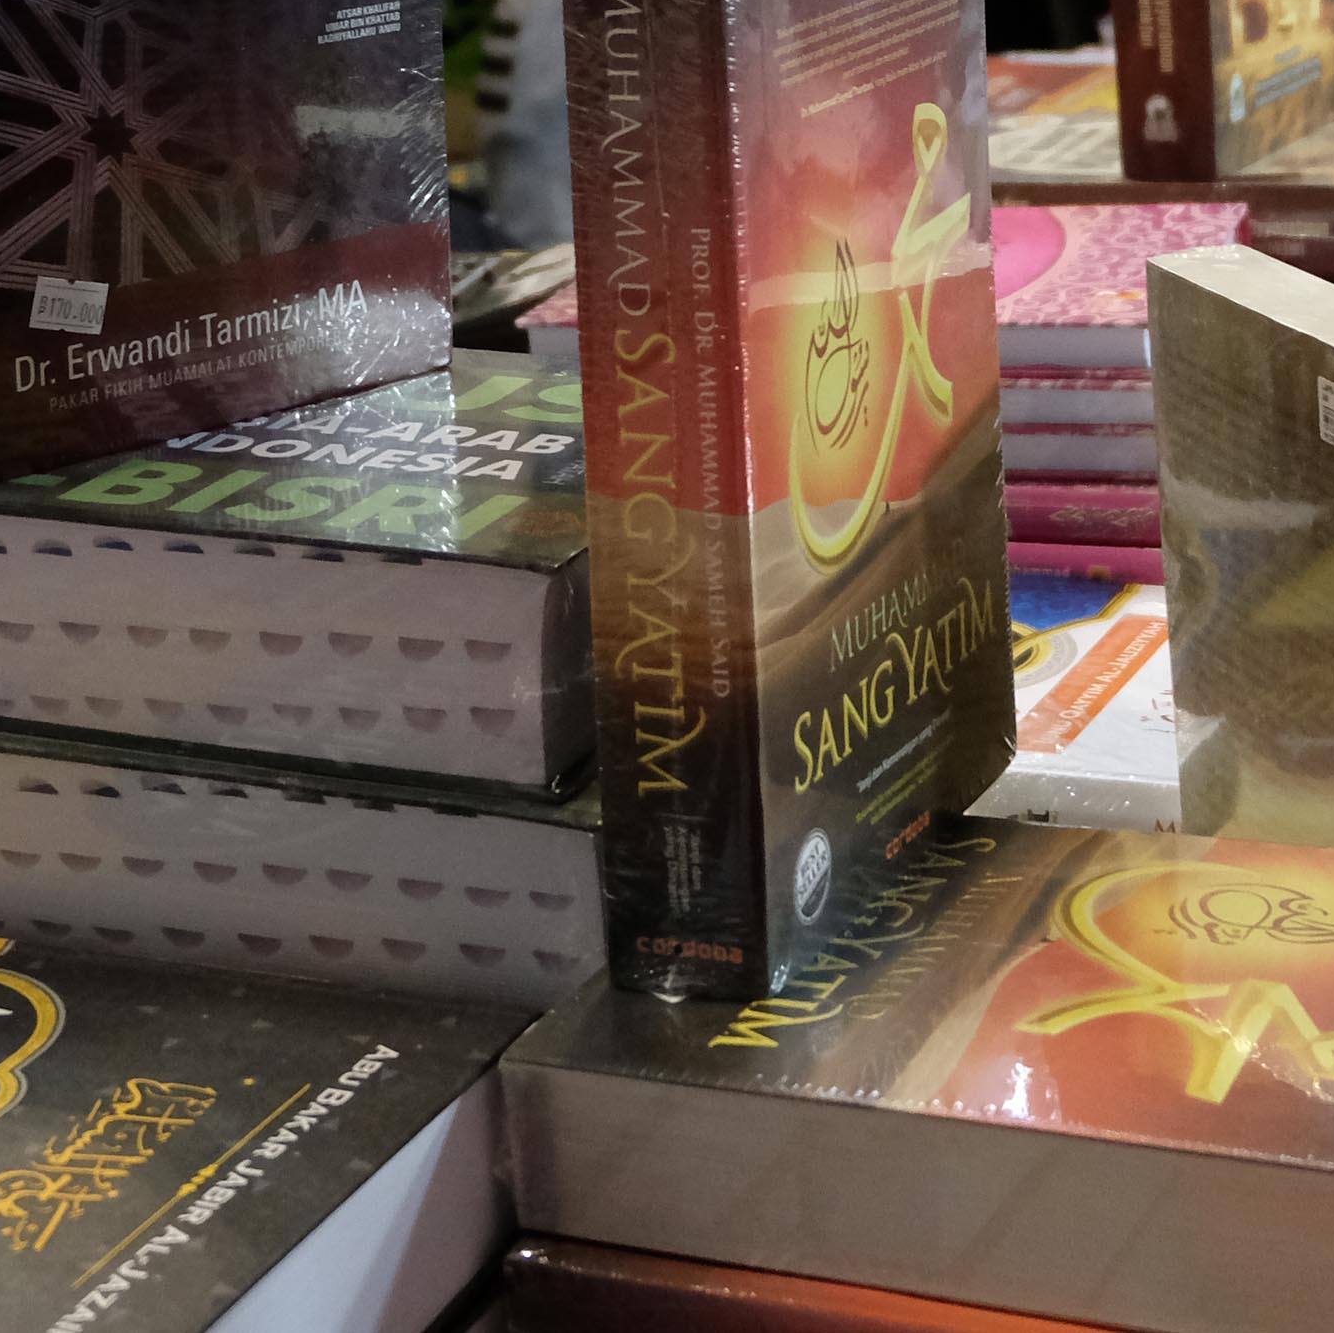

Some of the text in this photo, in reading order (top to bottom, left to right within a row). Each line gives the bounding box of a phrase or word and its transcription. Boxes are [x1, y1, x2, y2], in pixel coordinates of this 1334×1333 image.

[689, 226, 714, 302] PROF.
[15, 354, 57, 394] Dr.
[67, 319, 192, 380] Erwandi
[317, 278, 368, 322] MA
[49, 387, 100, 412] PAKAR
[104, 377, 144, 398] FIKIH
[148, 356, 233, 390] MUAMALAT
[614, 328, 679, 544] SANG
[696, 367, 723, 521] MUHAMMAD
[700, 526, 725, 629] SAMEH
[615, 530, 707, 798] YATIM
[711, 638, 729, 699] SAID
[793, 658, 896, 795] SANG
[884, 576, 997, 706] YATIM
[1061, 678, 1106, 721] QAYYIM
[338, 1043, 401, 1092] ABU
[253, 1083, 349, 1161] BAKAR
[178, 1154, 266, 1227] JABIR
